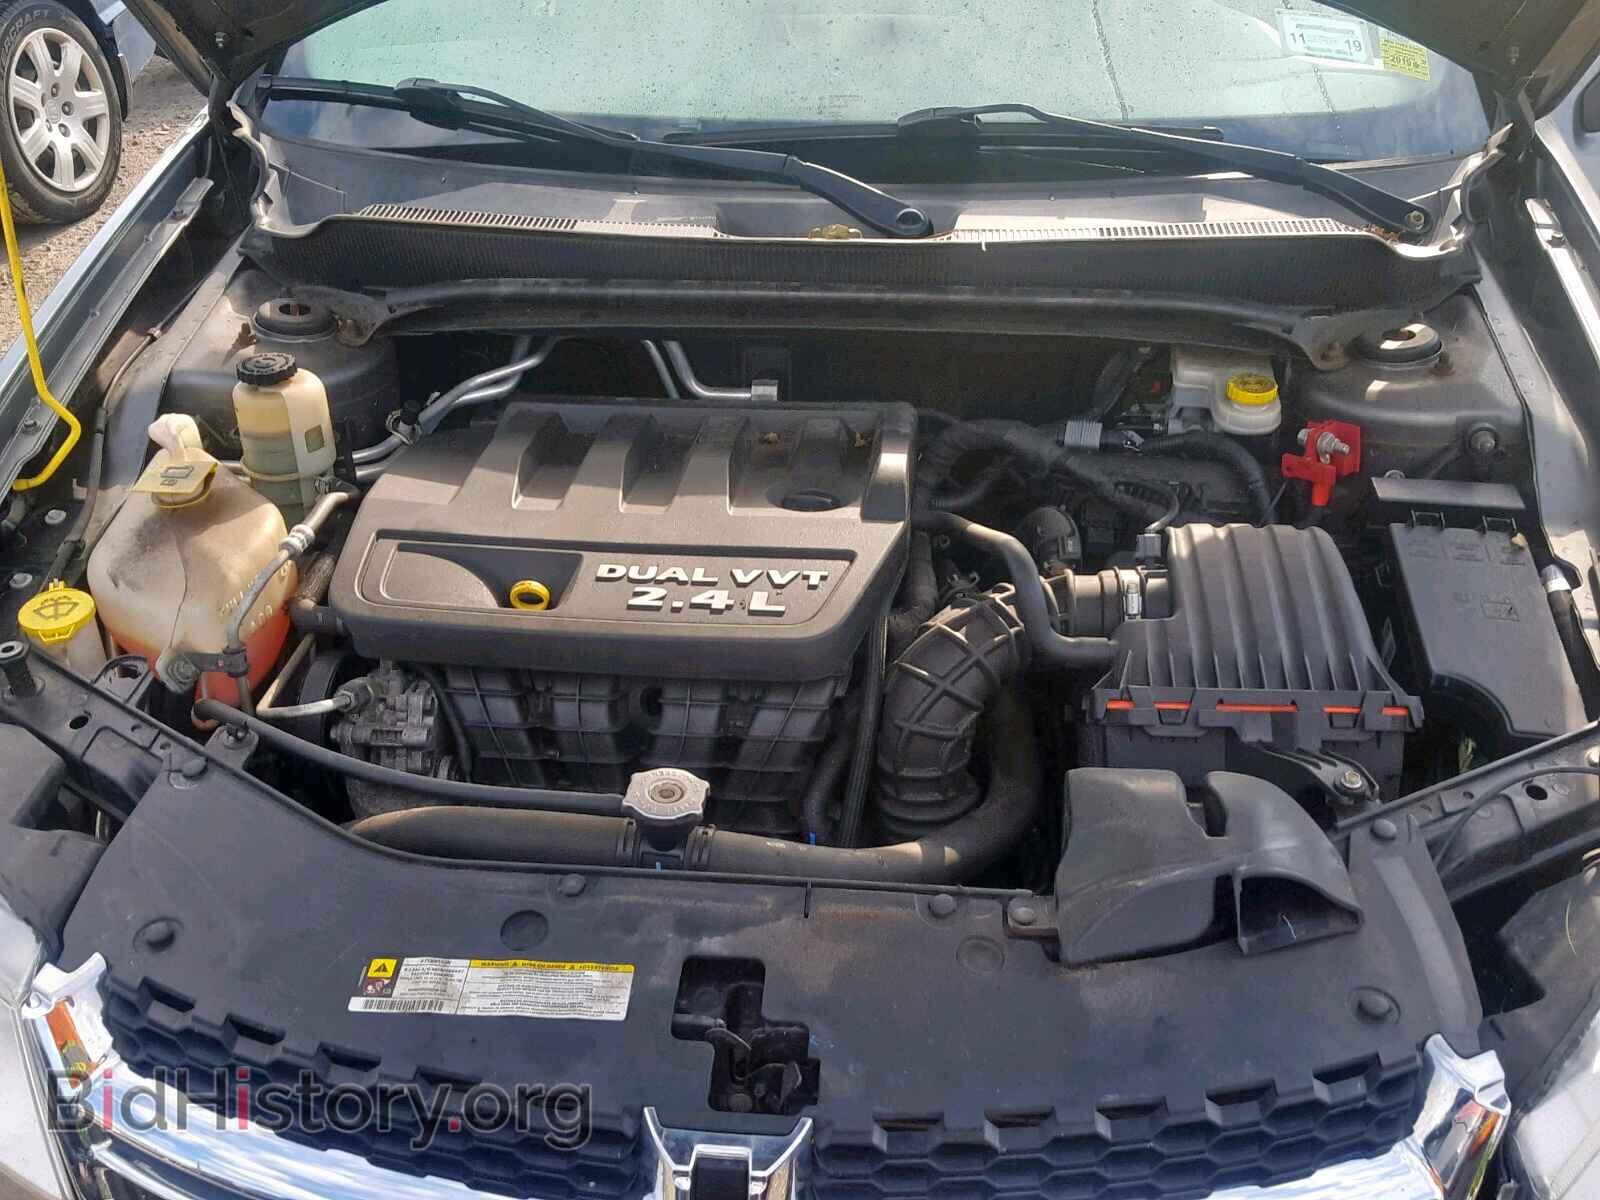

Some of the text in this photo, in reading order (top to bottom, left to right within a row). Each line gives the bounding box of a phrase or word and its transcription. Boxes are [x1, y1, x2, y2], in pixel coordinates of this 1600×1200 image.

[1289, 32, 1306, 45] 11
[1344, 39, 1362, 53] 19
[595, 563, 829, 590] DUAL VVT
